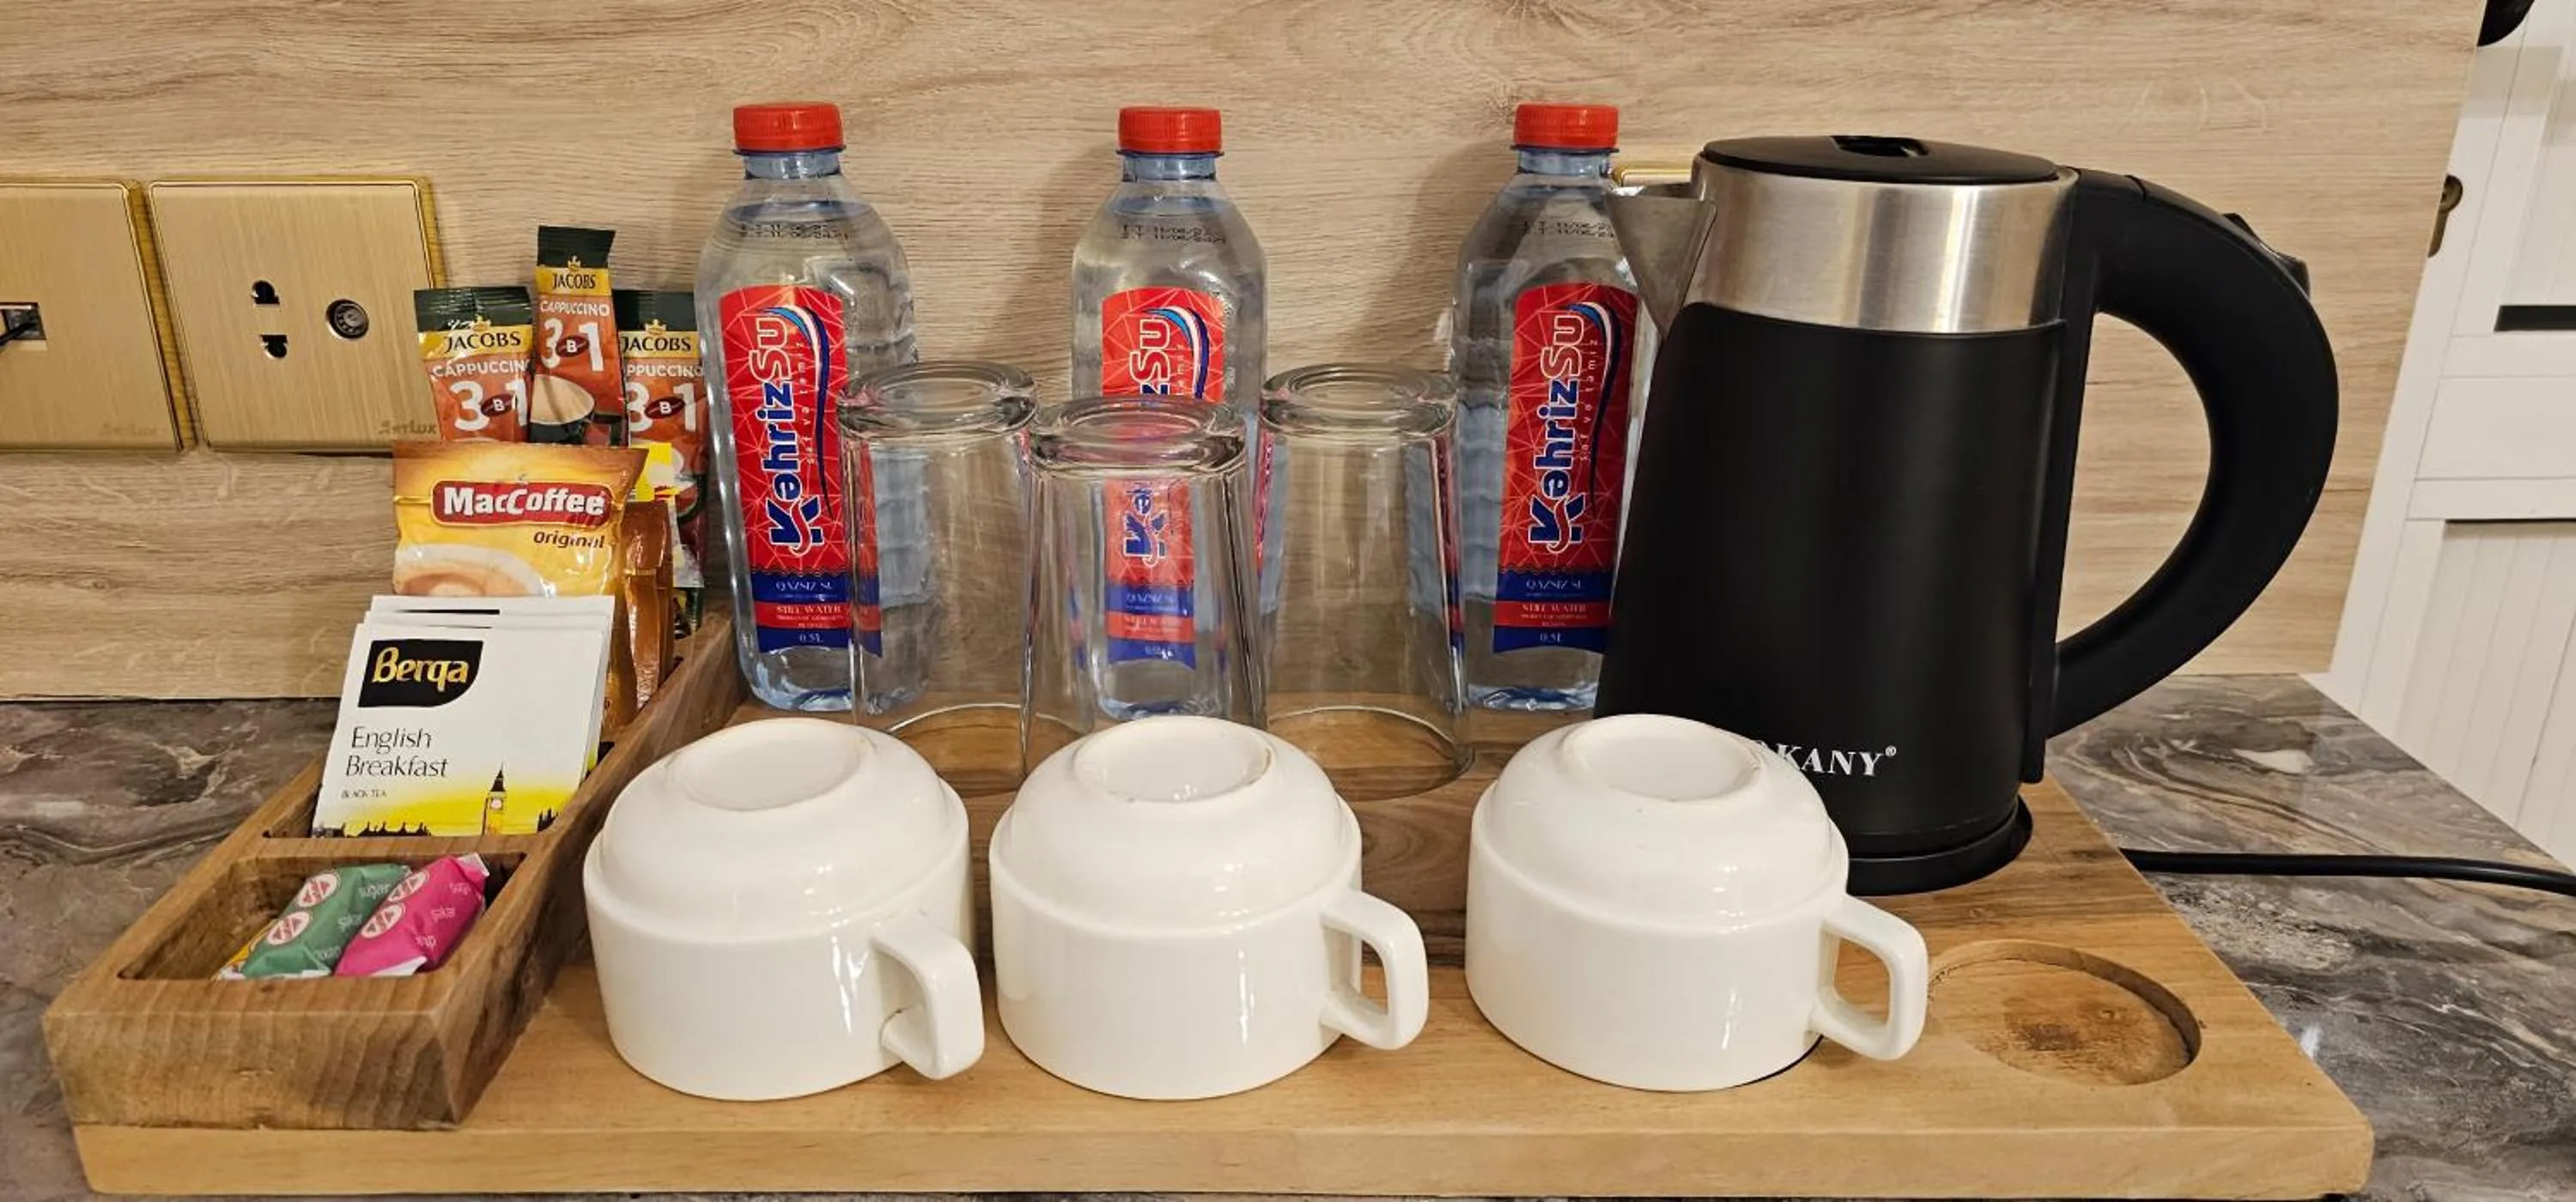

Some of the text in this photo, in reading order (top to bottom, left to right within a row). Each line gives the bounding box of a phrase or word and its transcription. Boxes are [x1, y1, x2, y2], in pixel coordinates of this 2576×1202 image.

[552, 274, 597, 289] JACOBS
[540, 300, 611, 317] CAPPUCCINO
[444, 331, 521, 354] JACOBS
[542, 318, 564, 369] 3
[578, 322, 605, 372] 1
[621, 336, 691, 353] JACOBS
[432, 358, 530, 378] CAPPUCCIN
[450, 379, 490, 431] 3
[505, 378, 528, 427] 1
[672, 382, 696, 432] 1
[443, 486, 605, 516] MacCoffee
[533, 530, 605, 549] Original
[351, 725, 432, 755] English
[345, 755, 448, 777] Breakfast
